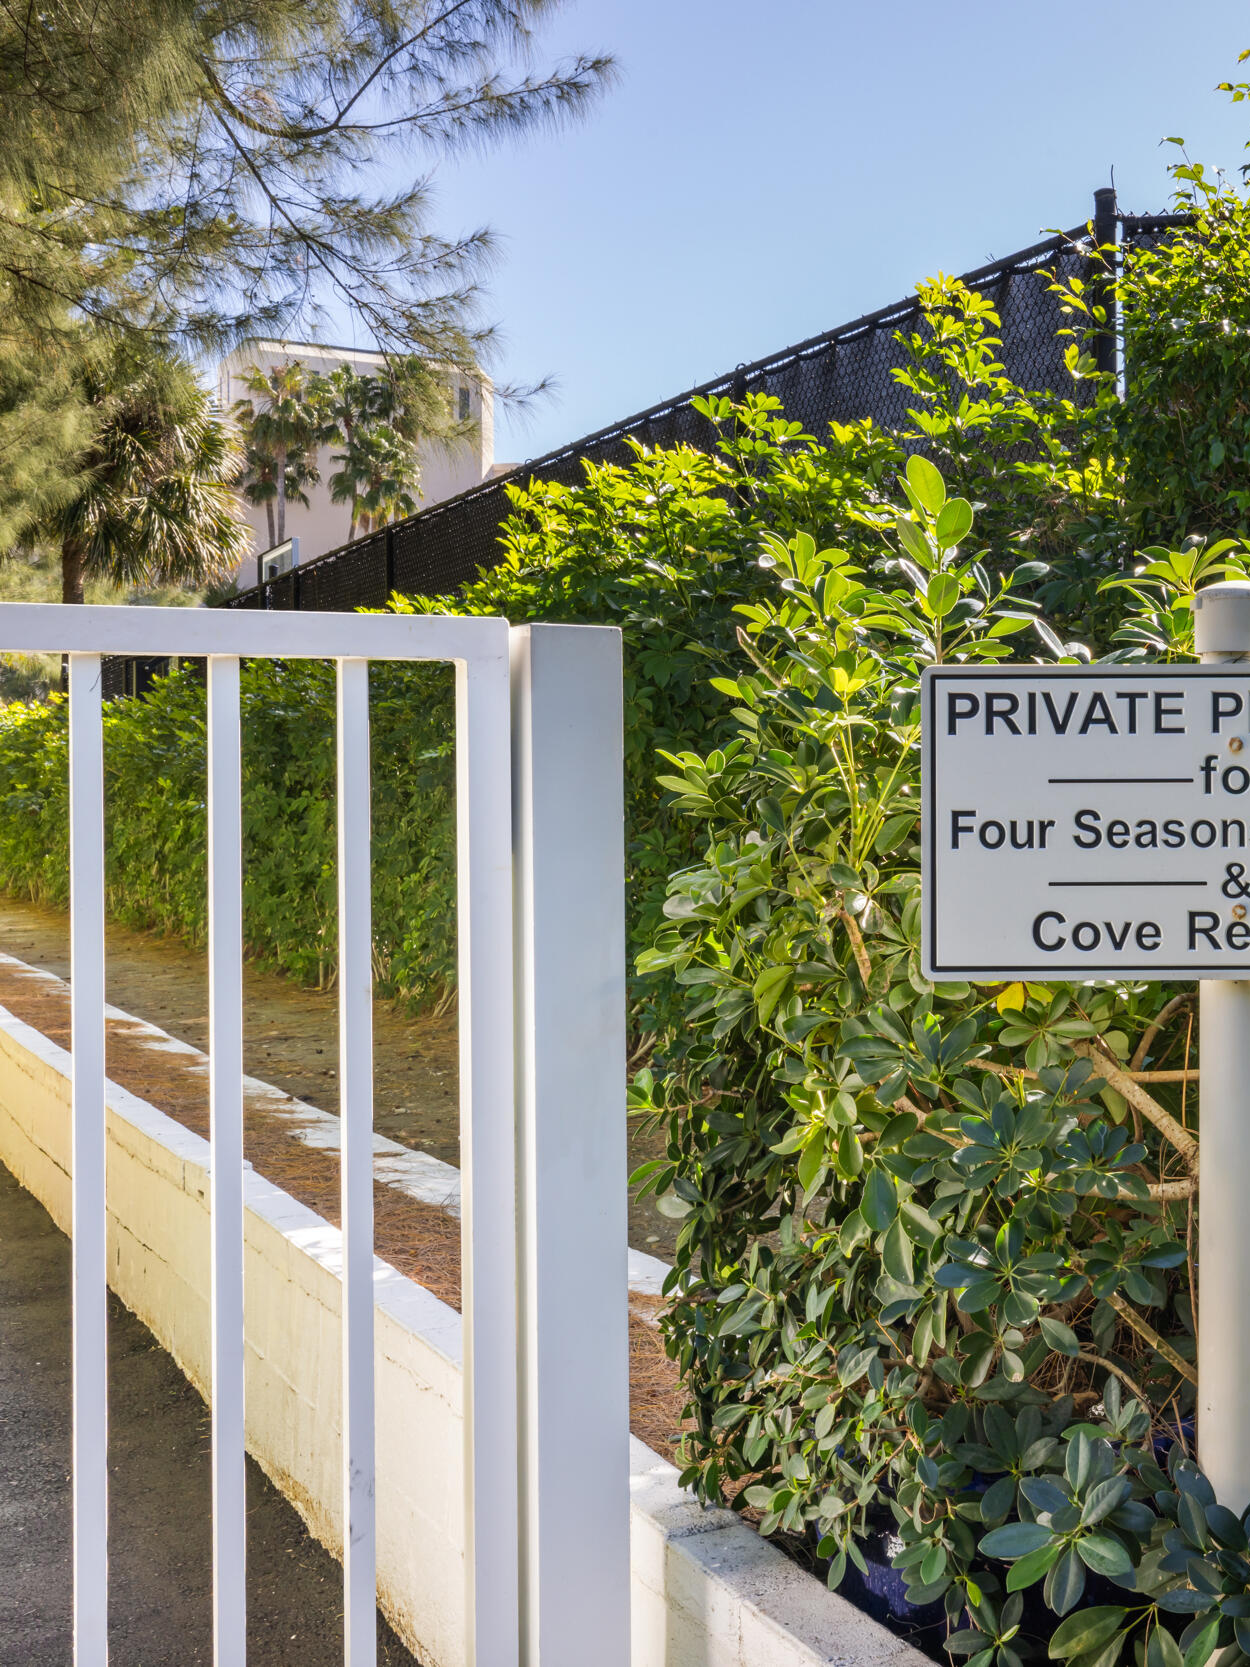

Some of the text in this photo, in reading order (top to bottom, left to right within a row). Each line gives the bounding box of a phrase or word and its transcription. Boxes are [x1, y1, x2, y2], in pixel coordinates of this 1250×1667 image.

[947, 691, 1186, 736] PRIVATE
[951, 810, 1056, 850] Four
[1031, 910, 1163, 952] Cove
